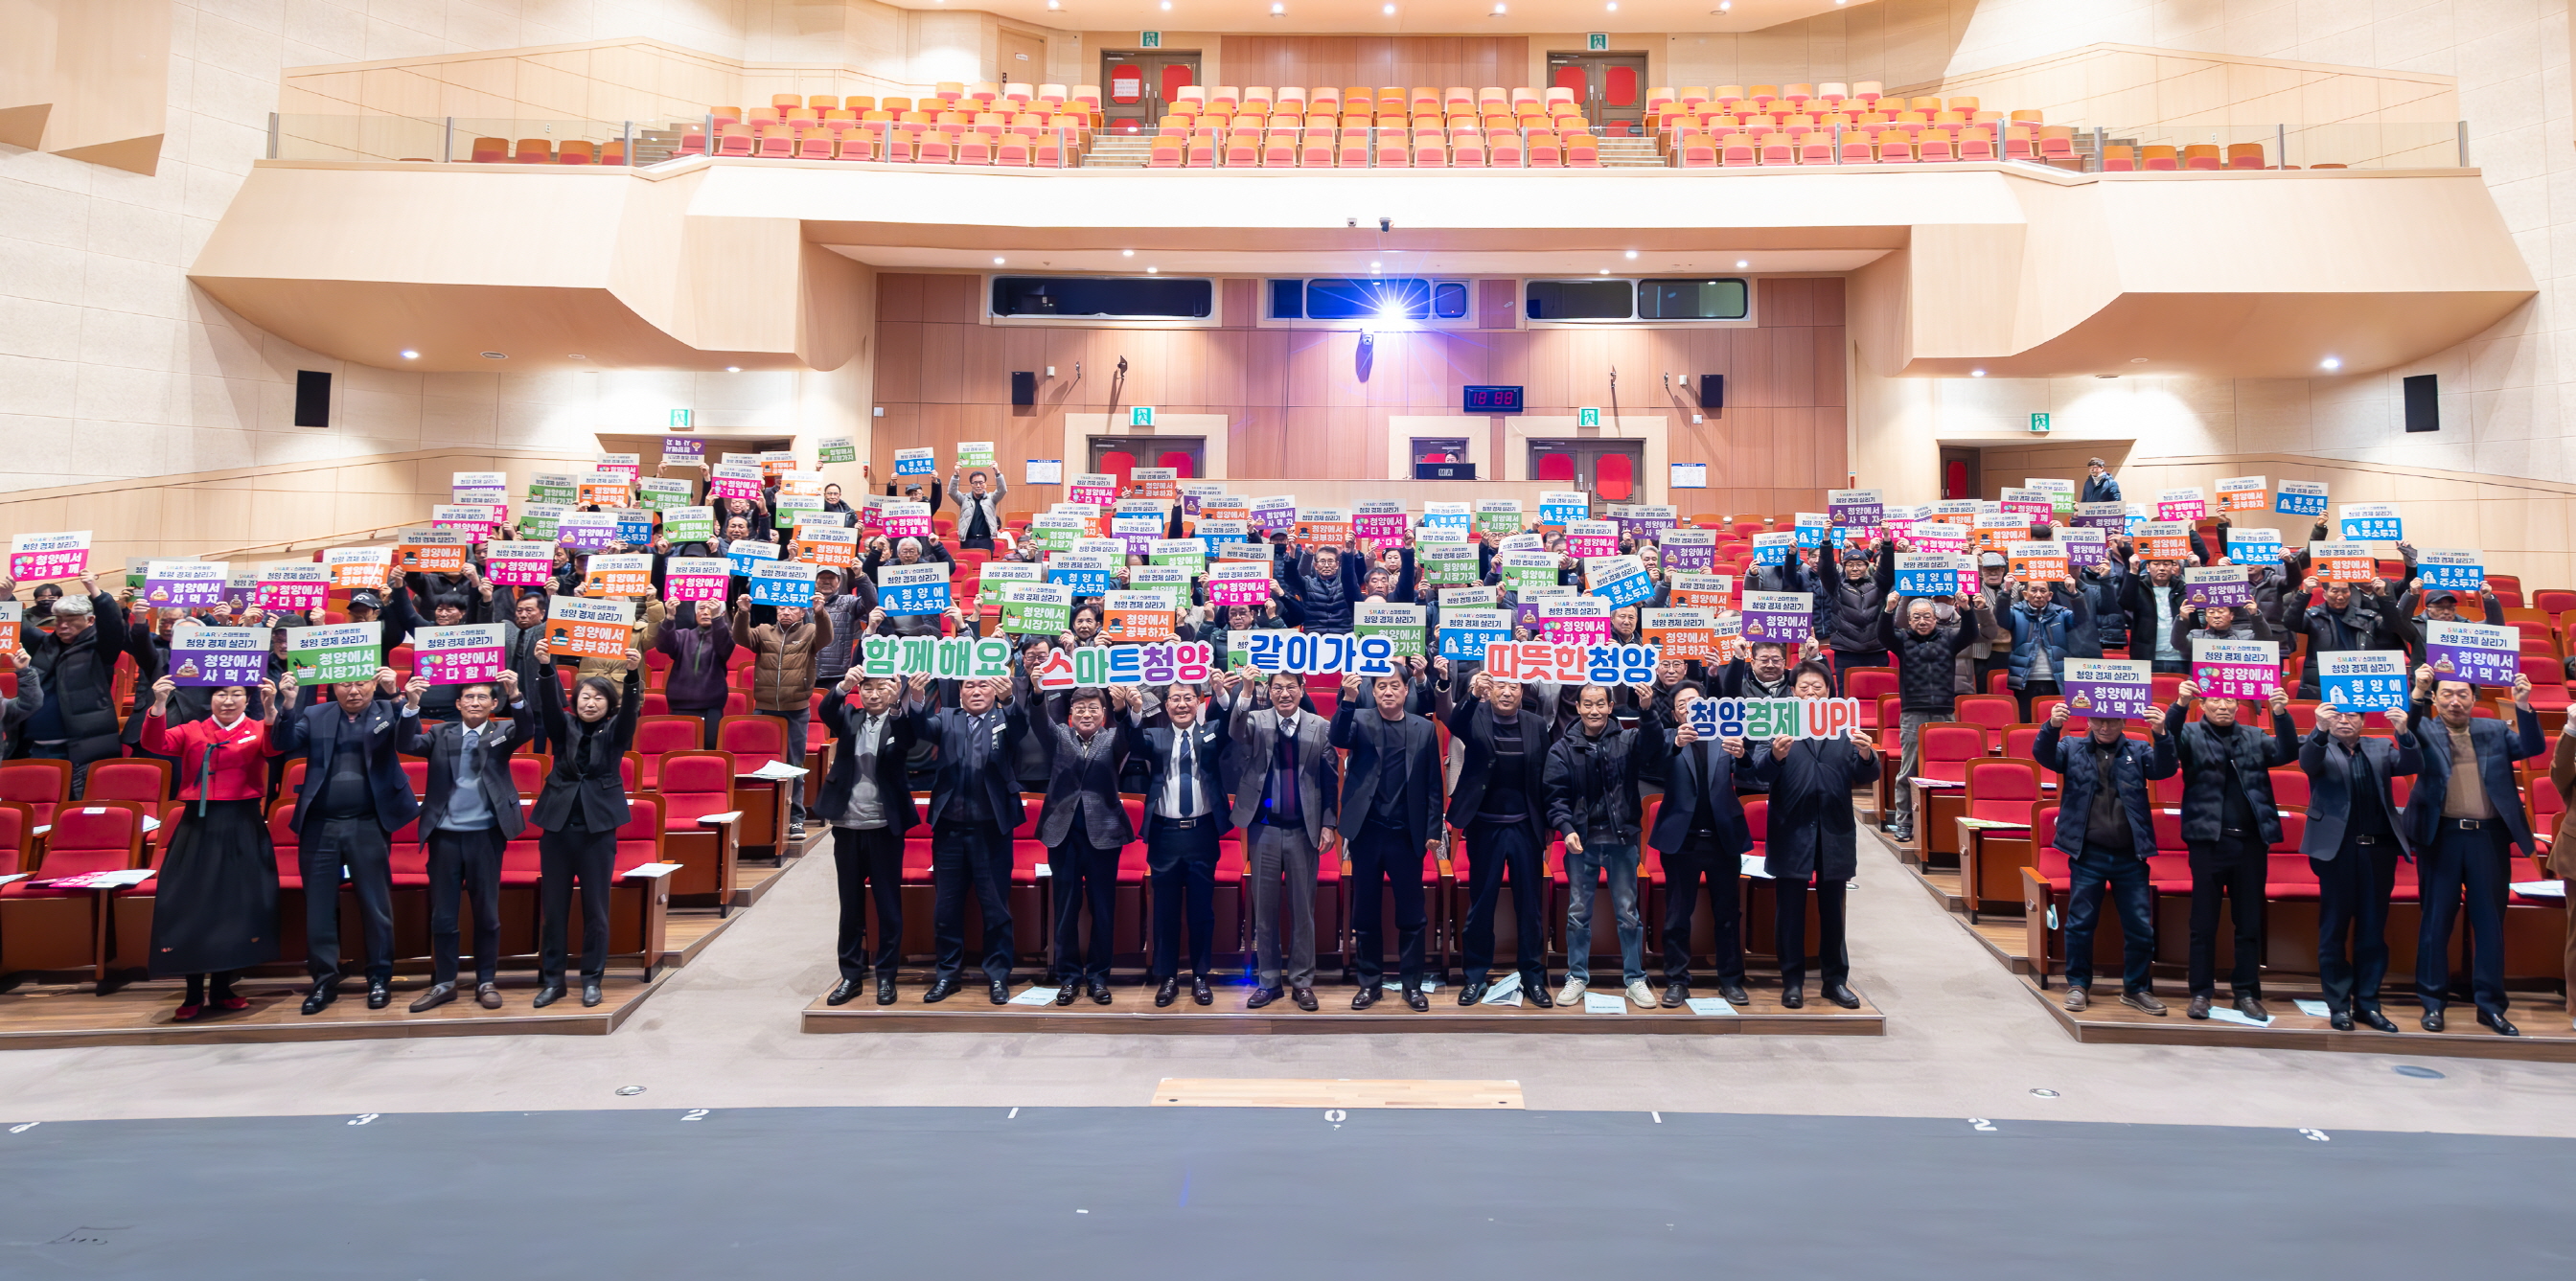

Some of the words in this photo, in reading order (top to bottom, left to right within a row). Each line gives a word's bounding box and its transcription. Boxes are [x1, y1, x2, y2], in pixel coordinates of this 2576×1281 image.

[2232, 492, 2262, 501] 청양에서
[2017, 505, 2047, 514] 청양에서
[678, 521, 709, 532] 청양에서
[899, 517, 928, 527] 청양에서
[1369, 515, 1402, 526] 청양에서
[2152, 538, 2185, 547] 청양에서
[421, 547, 459, 557] 청양에서
[816, 544, 850, 554] 청양에서
[1680, 547, 1710, 556] 청양에서
[35, 552, 81, 565] 청양에서
[2028, 560, 2062, 568] 청양에서
[508, 561, 546, 571] 청양에서
[1443, 562, 1475, 571] 청양에서
[607, 573, 644, 583] 청양에서
[686, 578, 723, 587] 청양에서
[887, 575, 901, 583] 청양
[903, 574, 916, 583] 경제
[172, 582, 219, 593] 청양에서
[280, 584, 323, 595] 청양에서
[1230, 582, 1264, 591] 청양에서
[2208, 584, 2244, 594] 청양에서
[902, 598, 947, 612] 주소두자
[560, 608, 576, 618] 청양
[579, 609, 595, 619] 경제
[597, 611, 621, 622] 살리기
[1024, 606, 1065, 619] 청양에서
[1022, 619, 1067, 631] 시장가자
[1126, 614, 1168, 625] 청양에서
[1766, 615, 1806, 627] 청양에서
[1563, 621, 1604, 631] 청양에서
[573, 625, 624, 640] 청양에서
[1126, 626, 1170, 639] 공부하자
[1377, 629, 1419, 641] 청양에서
[1666, 632, 1708, 642] 청양에서
[186, 639, 205, 648] 청양
[208, 639, 226, 648] 경제
[229, 639, 256, 648] 살리기
[300, 637, 317, 648] 청양
[321, 636, 338, 647] 경제
[341, 634, 367, 645] 살리기
[427, 637, 445, 648] 청양
[448, 637, 465, 647] 경제
[467, 636, 492, 646] 살리기
[2440, 634, 2458, 644] 청양
[2461, 634, 2478, 645] 경제
[2481, 635, 2506, 646] 살리기
[571, 639, 622, 654] 공부하자
[1666, 644, 1711, 657] 공부하자
[319, 649, 374, 665] 청양에서
[446, 652, 496, 665] 청양에서
[865, 638, 1007, 675] 함께해요
[1251, 634, 1392, 673] 같이가요
[2205, 652, 2221, 660] 청양
[2243, 652, 2267, 661] 살리기
[2459, 651, 2512, 667] 청양에서
[204, 652, 261, 669] 청양에서
[1042, 644, 1210, 686] 스마트청양
[1488, 644, 1659, 683] 따뜻한청양
[319, 663, 376, 679] 시장가자
[2222, 668, 2272, 680] 청양에서
[2332, 664, 2349, 673] 청양
[2351, 664, 2368, 673] 경제
[2370, 663, 2394, 672] 살리기
[2076, 671, 2092, 679] 청양
[2095, 671, 2111, 679] 경제
[2114, 672, 2138, 680] 살리기
[2094, 686, 2145, 699] 청양에서
[2353, 693, 2403, 708] 주소두자
[1690, 701, 1799, 737] 청양경제
[1808, 701, 1856, 736] UP!
[347, 1113, 380, 1126] 3
[680, 1109, 709, 1121] 2
[1967, 1118, 1998, 1132] 2
[2298, 1128, 2331, 1141] 3
